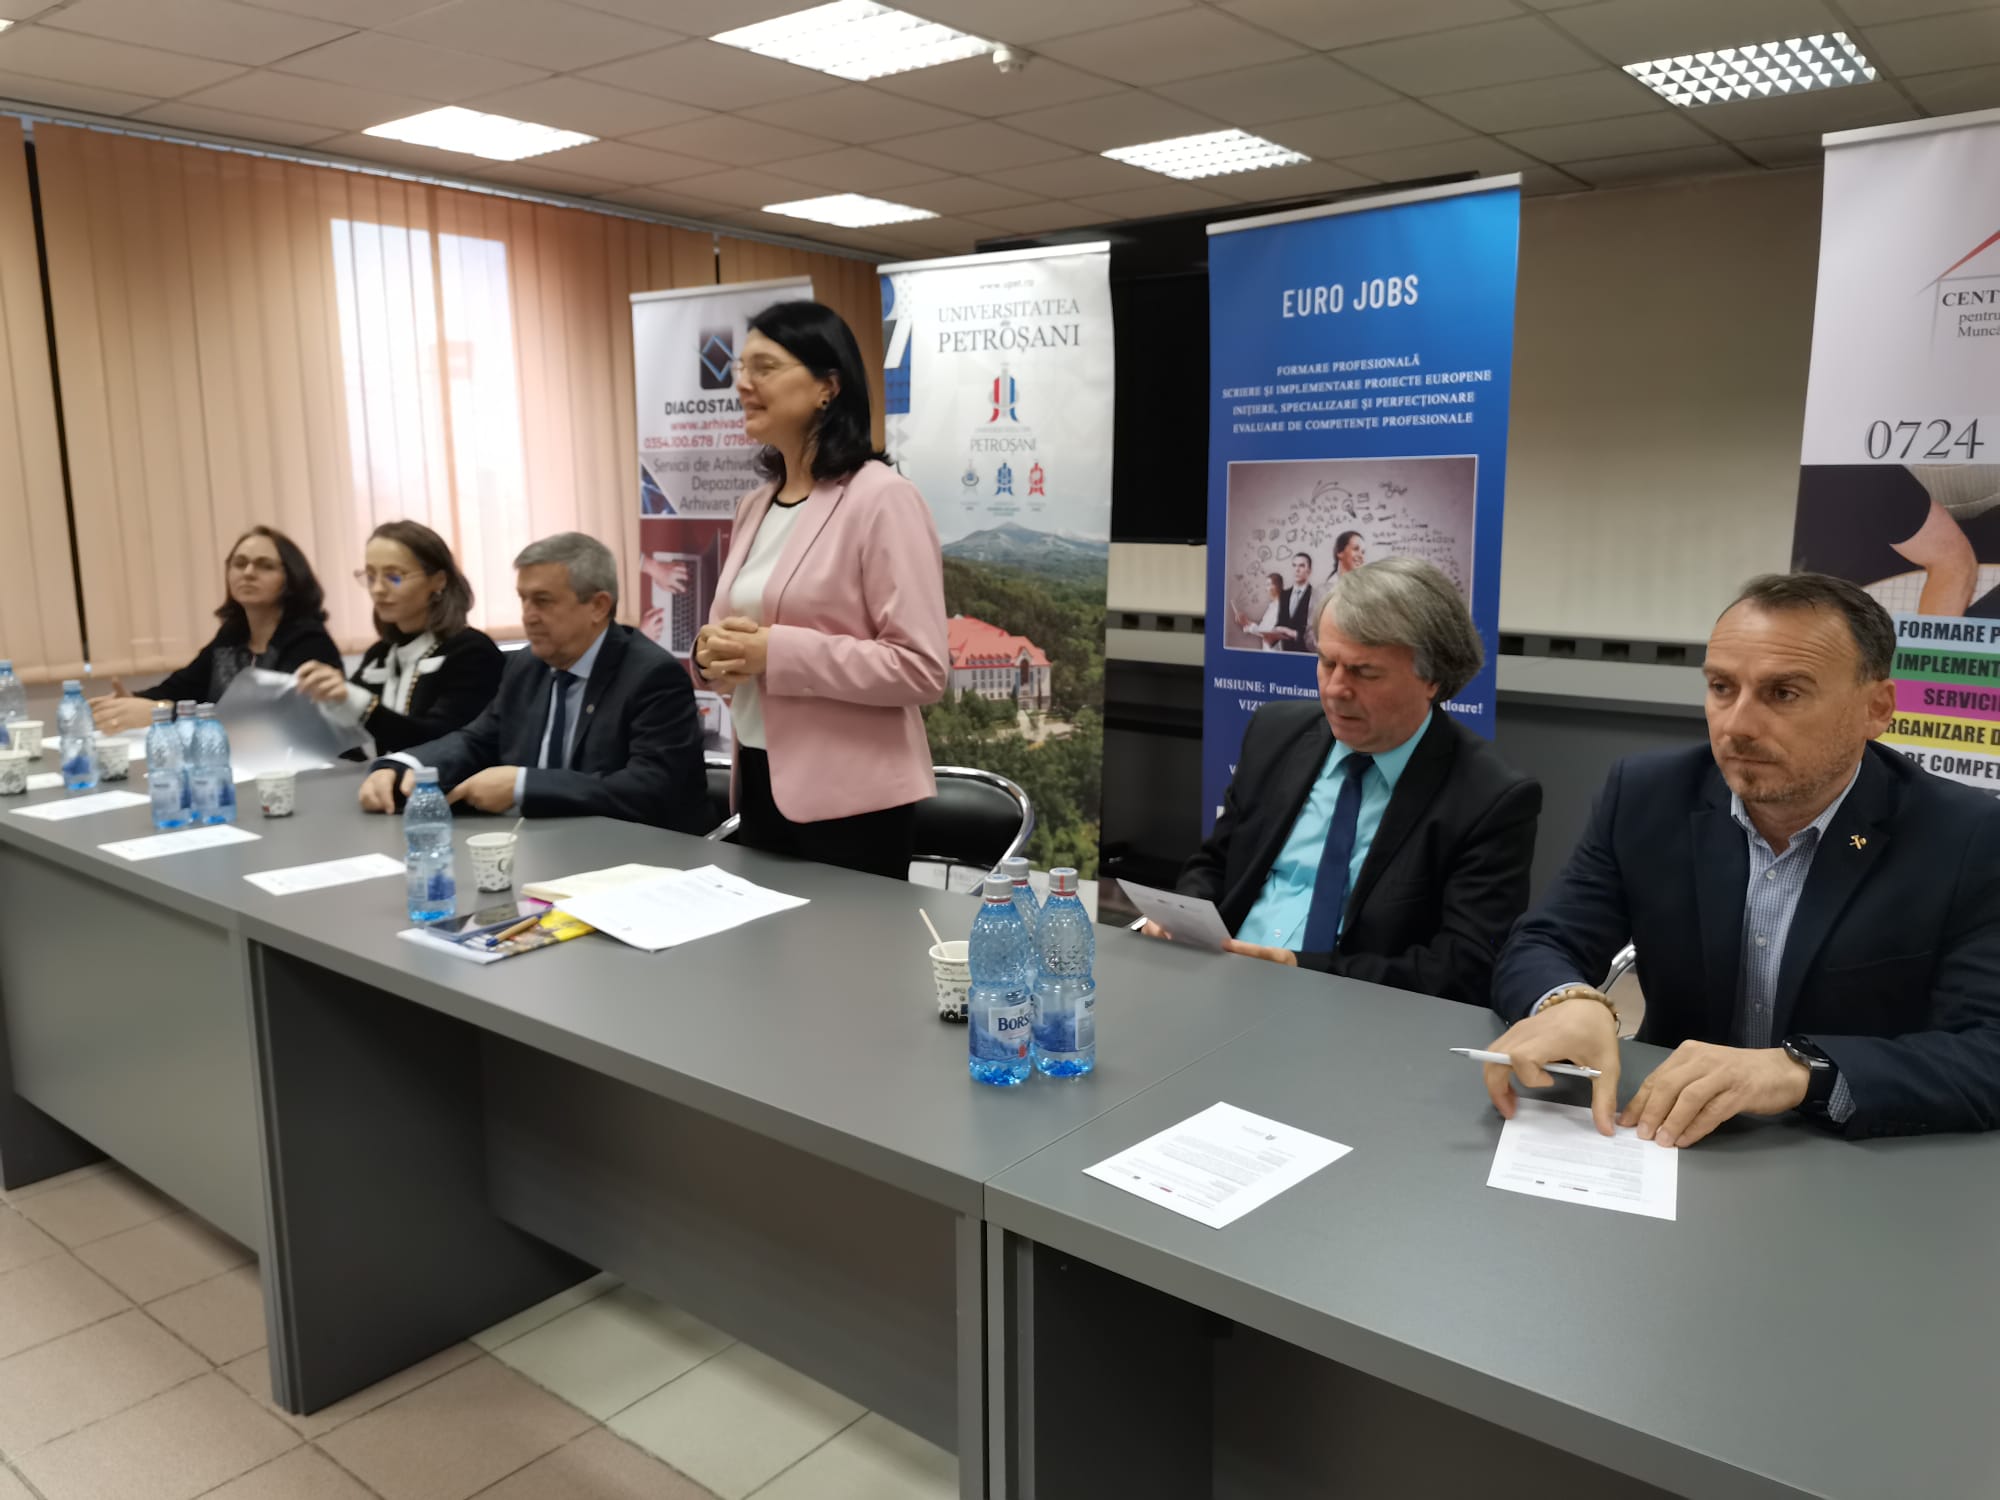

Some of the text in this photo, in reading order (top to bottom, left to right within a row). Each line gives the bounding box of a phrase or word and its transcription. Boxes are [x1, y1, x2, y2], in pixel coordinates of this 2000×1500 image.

[1282, 274, 1419, 318] EURO JOBS
[1942, 289, 2000, 307] CENT
[938, 298, 1081, 322] UNIVERSITATEA
[1958, 311, 2000, 326] pentru
[937, 323, 1081, 353] PETROȘANI
[1276, 352, 1420, 376] FORMARE PROFESIONALĂ
[1222, 386, 1261, 399] SCRIERE
[1276, 379, 1361, 395] IMPLEMENTARE
[1364, 374, 1422, 389] PROIECTE
[1425, 369, 1493, 386] EUROPENE
[1280, 398, 1358, 414] SPECIALIZARE
[1375, 391, 1475, 408] PERFECȚIONARE
[1232, 412, 1474, 434] EVALUARE DE COMPETENȚE PROFESIONALE
[1864, 418, 1985, 461] 0724
[693, 457, 711, 472] de
[691, 475, 760, 493] Depozitare
[679, 496, 731, 512] Arhivare
[1898, 620, 1986, 643] FORMARE
[1896, 653, 2000, 678] IMPLEMENT
[1213, 677, 1319, 698] MISIUNE: Furnizam
[1887, 717, 1986, 744] RGANIZARE
